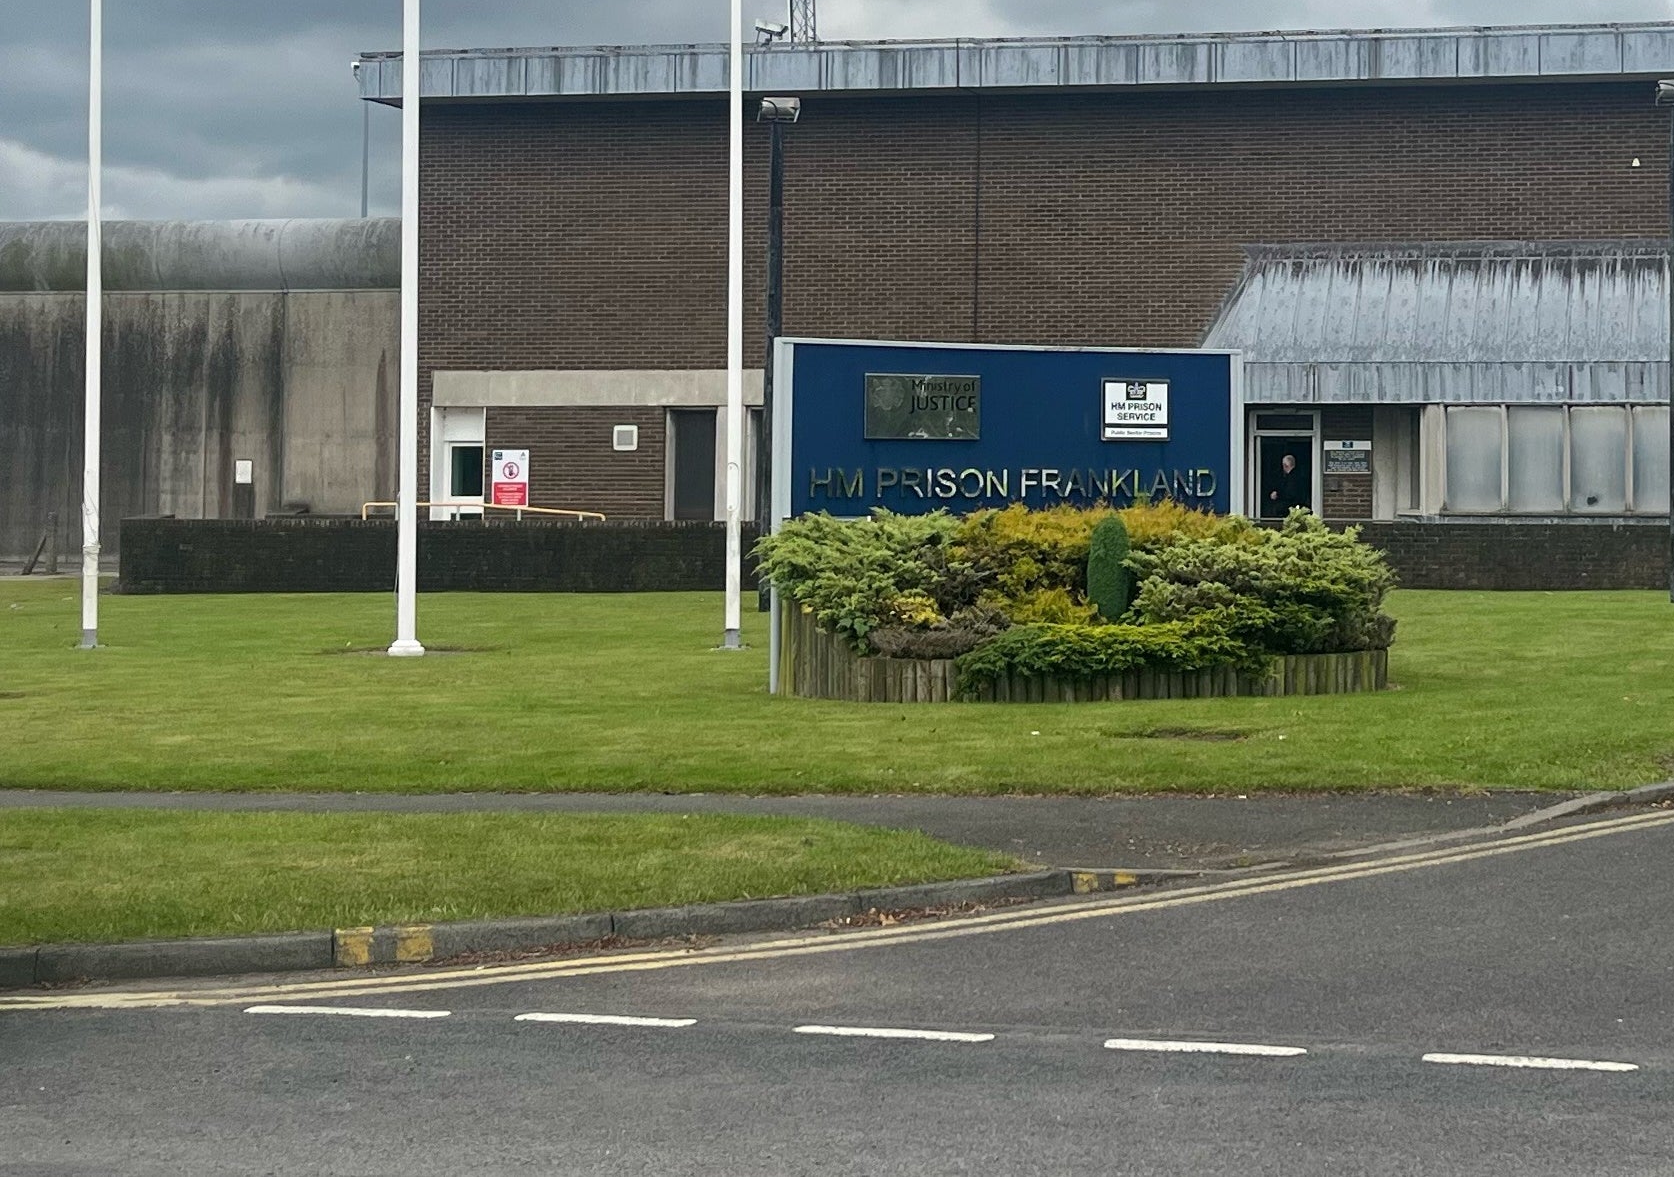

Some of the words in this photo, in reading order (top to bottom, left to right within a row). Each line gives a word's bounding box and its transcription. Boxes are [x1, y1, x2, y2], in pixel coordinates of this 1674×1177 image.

[911, 379, 962, 395] Ministry
[963, 380, 976, 392] of
[909, 395, 977, 414] JUSTICE
[1111, 402, 1126, 411] HM
[1128, 403, 1162, 412] PRISON
[1117, 413, 1156, 421] SERVICE
[810, 468, 864, 499] HM
[876, 468, 1008, 499] PRISON
[1019, 468, 1218, 499] FRANKLAND
